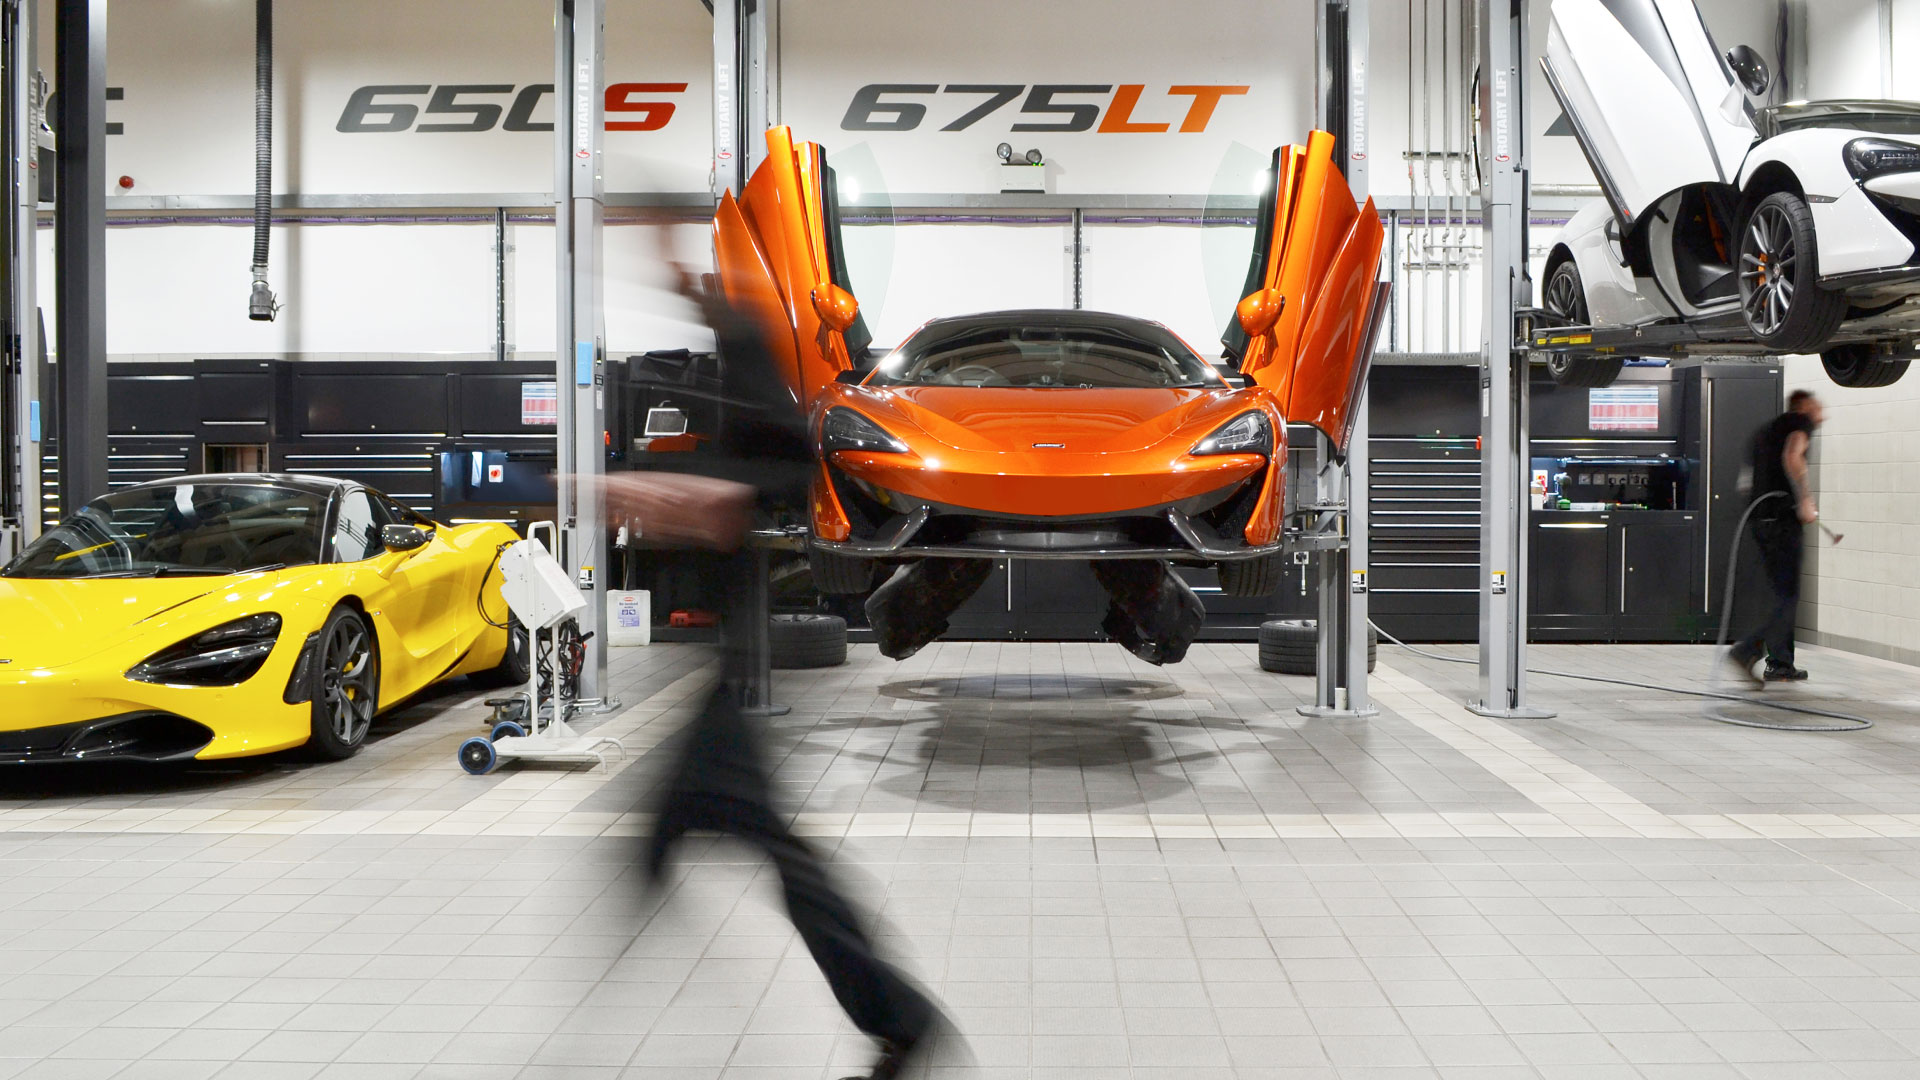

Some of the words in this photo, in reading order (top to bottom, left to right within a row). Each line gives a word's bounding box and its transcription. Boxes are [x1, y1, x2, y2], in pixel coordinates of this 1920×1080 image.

[30, 76, 38, 104] LIFT
[718, 62, 729, 91] LIFT
[1352, 66, 1364, 95] LIFT
[1495, 68, 1507, 97] LIFT
[30, 107, 38, 159] ROTARY
[578, 94, 589, 149] ROTARY
[718, 93, 731, 148] ROTARY
[840, 84, 1250, 133] 675LT
[1353, 98, 1365, 152] ROTARY
[1496, 100, 1508, 154] ROTARY
